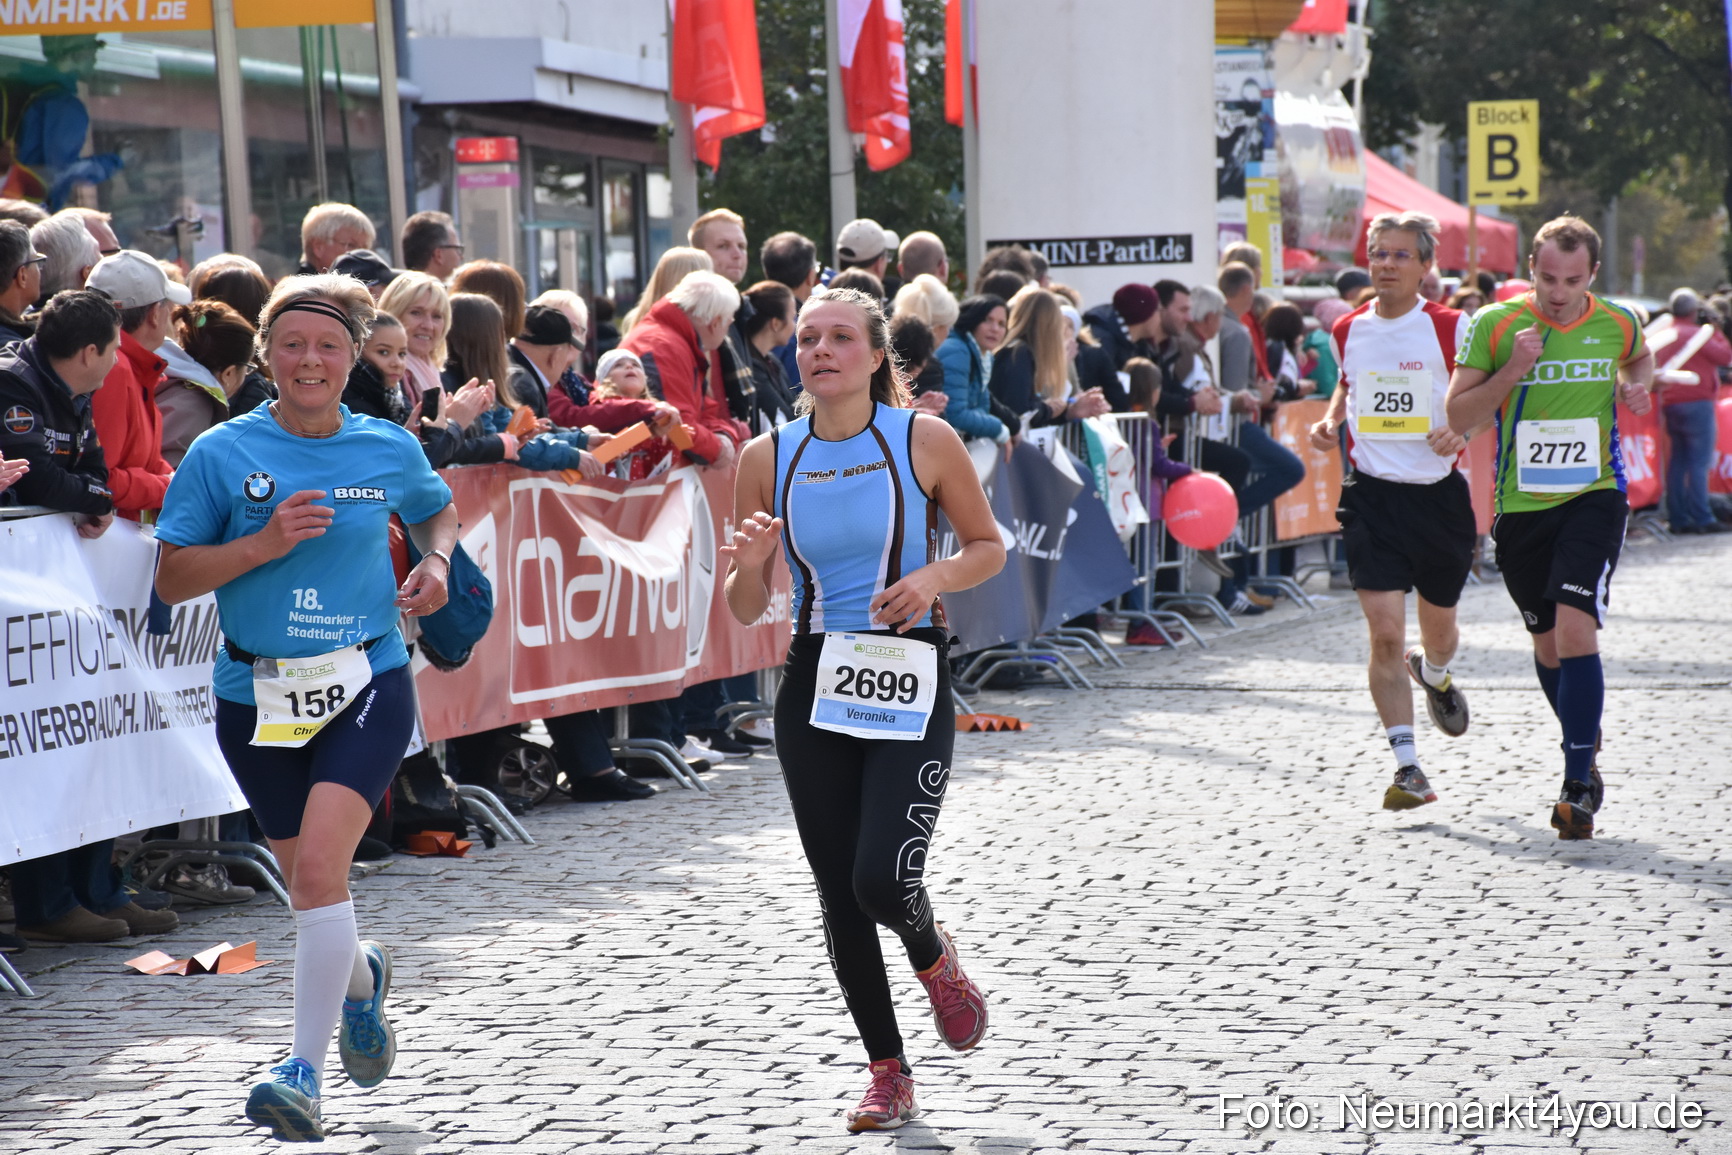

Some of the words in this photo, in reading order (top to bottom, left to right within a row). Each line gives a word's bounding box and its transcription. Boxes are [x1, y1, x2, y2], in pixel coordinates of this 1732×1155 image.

[1477, 105, 1530, 125] Block
[1487, 134, 1520, 181] B
[1399, 361, 1423, 371] MID
[1374, 392, 1413, 413] 259
[1382, 420, 1405, 428] Albert
[1529, 441, 1587, 464] 2772
[246, 472, 273, 484] BMW
[333, 487, 386, 500] BOCK
[245, 505, 273, 515] PART
[292, 587, 324, 611] 18.
[288, 611, 355, 625] Neumarkter
[286, 625, 345, 642] Stadtlauf
[866, 645, 905, 657] BOCK
[296, 662, 336, 678] BOCK
[834, 665, 919, 705] 2699
[284, 684, 346, 719] 158
[20, 692, 140, 754] VERBRAUCH.
[847, 707, 896, 724] Veronika
